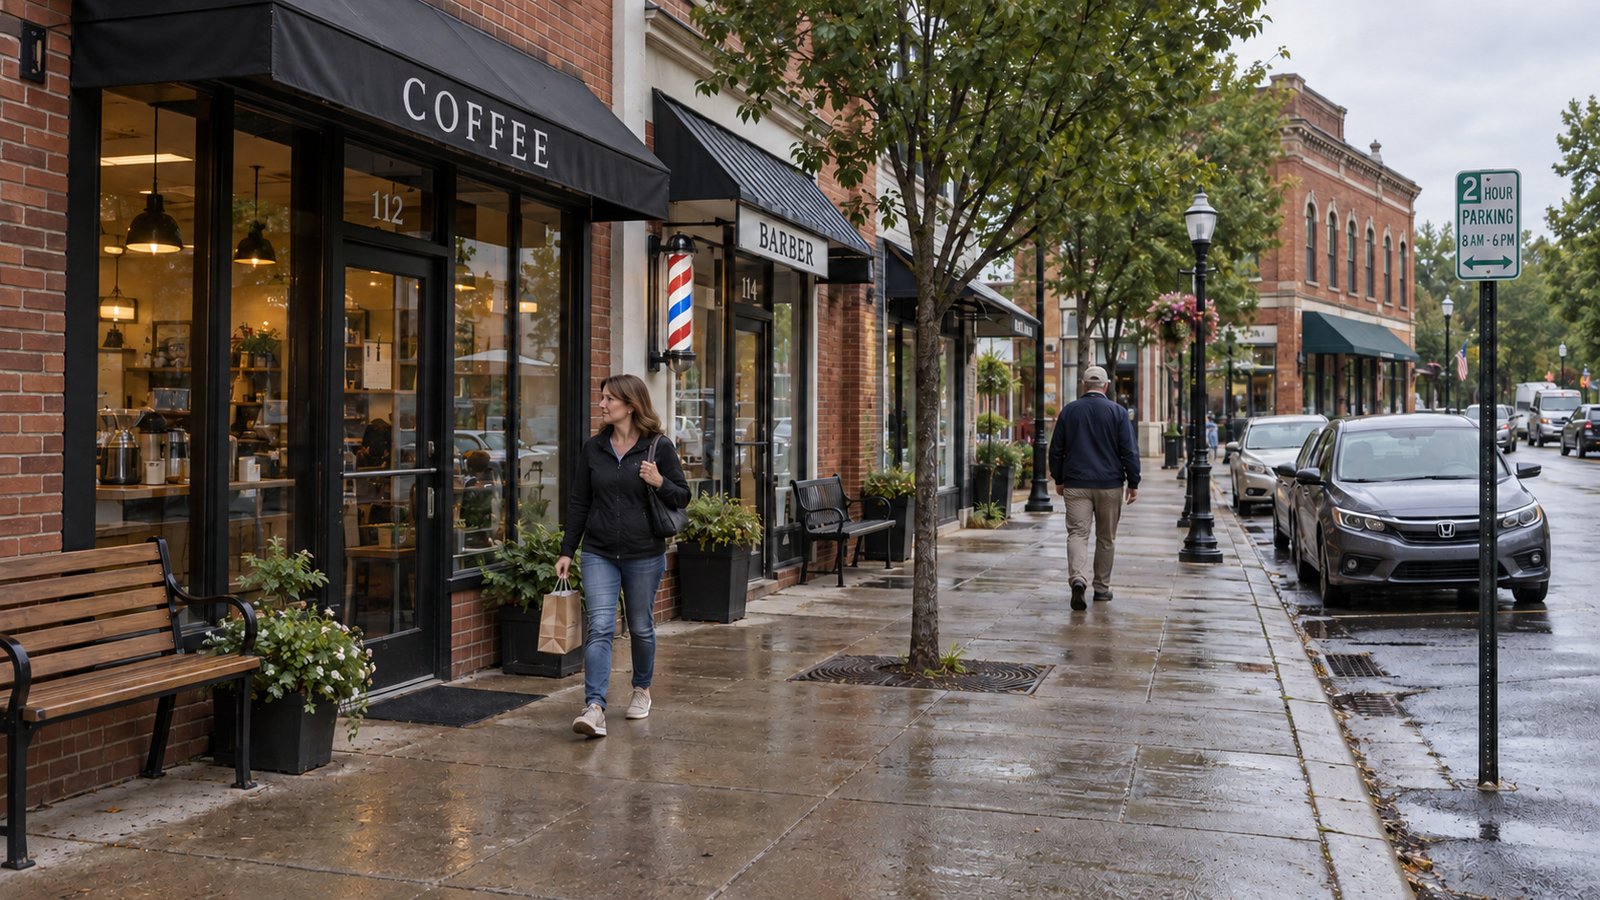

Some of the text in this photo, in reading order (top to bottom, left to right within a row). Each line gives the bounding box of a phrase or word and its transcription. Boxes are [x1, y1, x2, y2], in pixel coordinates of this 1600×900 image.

[403, 77, 549, 169] COFFEE
[1463, 176, 1513, 201] 2 HOUR
[372, 190, 404, 225] 112
[1462, 208, 1514, 225] PARKING
[759, 221, 814, 267] BARBER
[742, 277, 757, 301] 114
